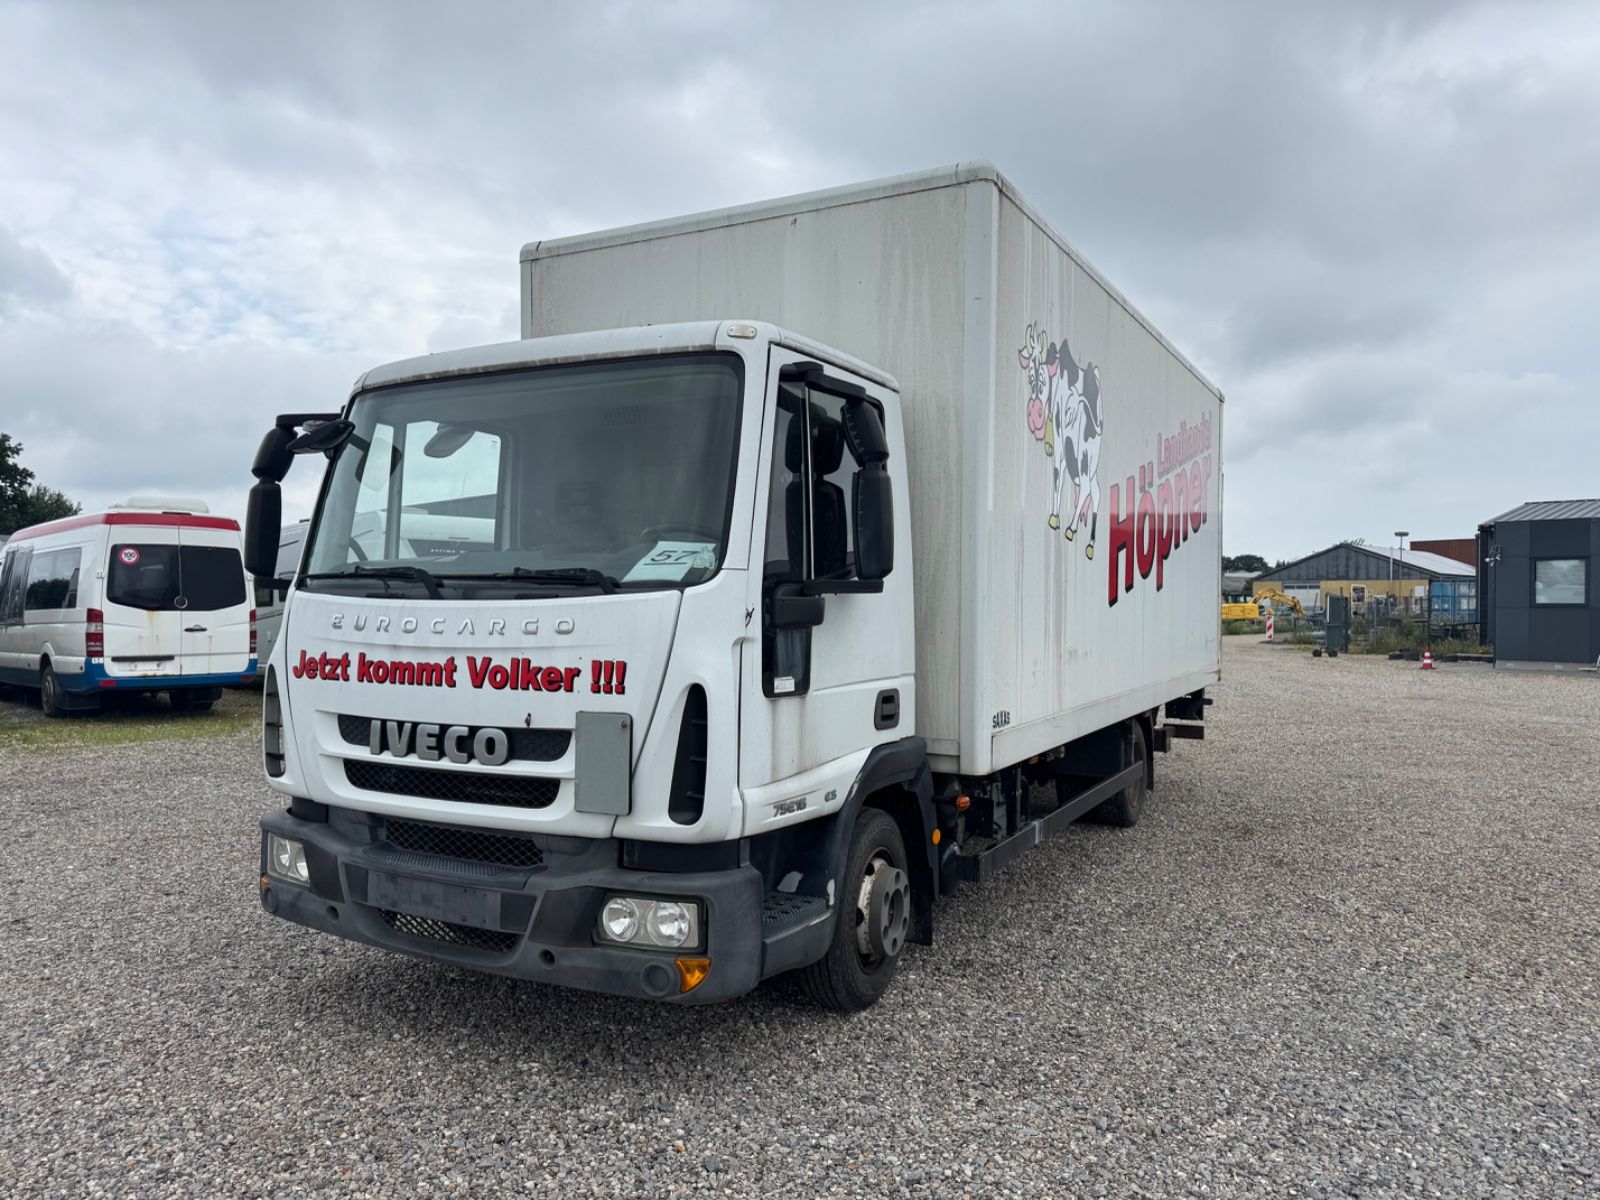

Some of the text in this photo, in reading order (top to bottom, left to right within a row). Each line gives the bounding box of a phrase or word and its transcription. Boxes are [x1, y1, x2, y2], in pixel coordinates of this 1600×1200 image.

[1157, 410, 1212, 479] Landhandel
[1108, 453, 1212, 608] Höpner
[650, 549, 701, 562] 57
[331, 613, 576, 636] EUROCARGO
[293, 650, 350, 682] Jetzt
[357, 652, 457, 687] kommt
[466, 656, 581, 693] Volker
[369, 719, 509, 767] IVECO
